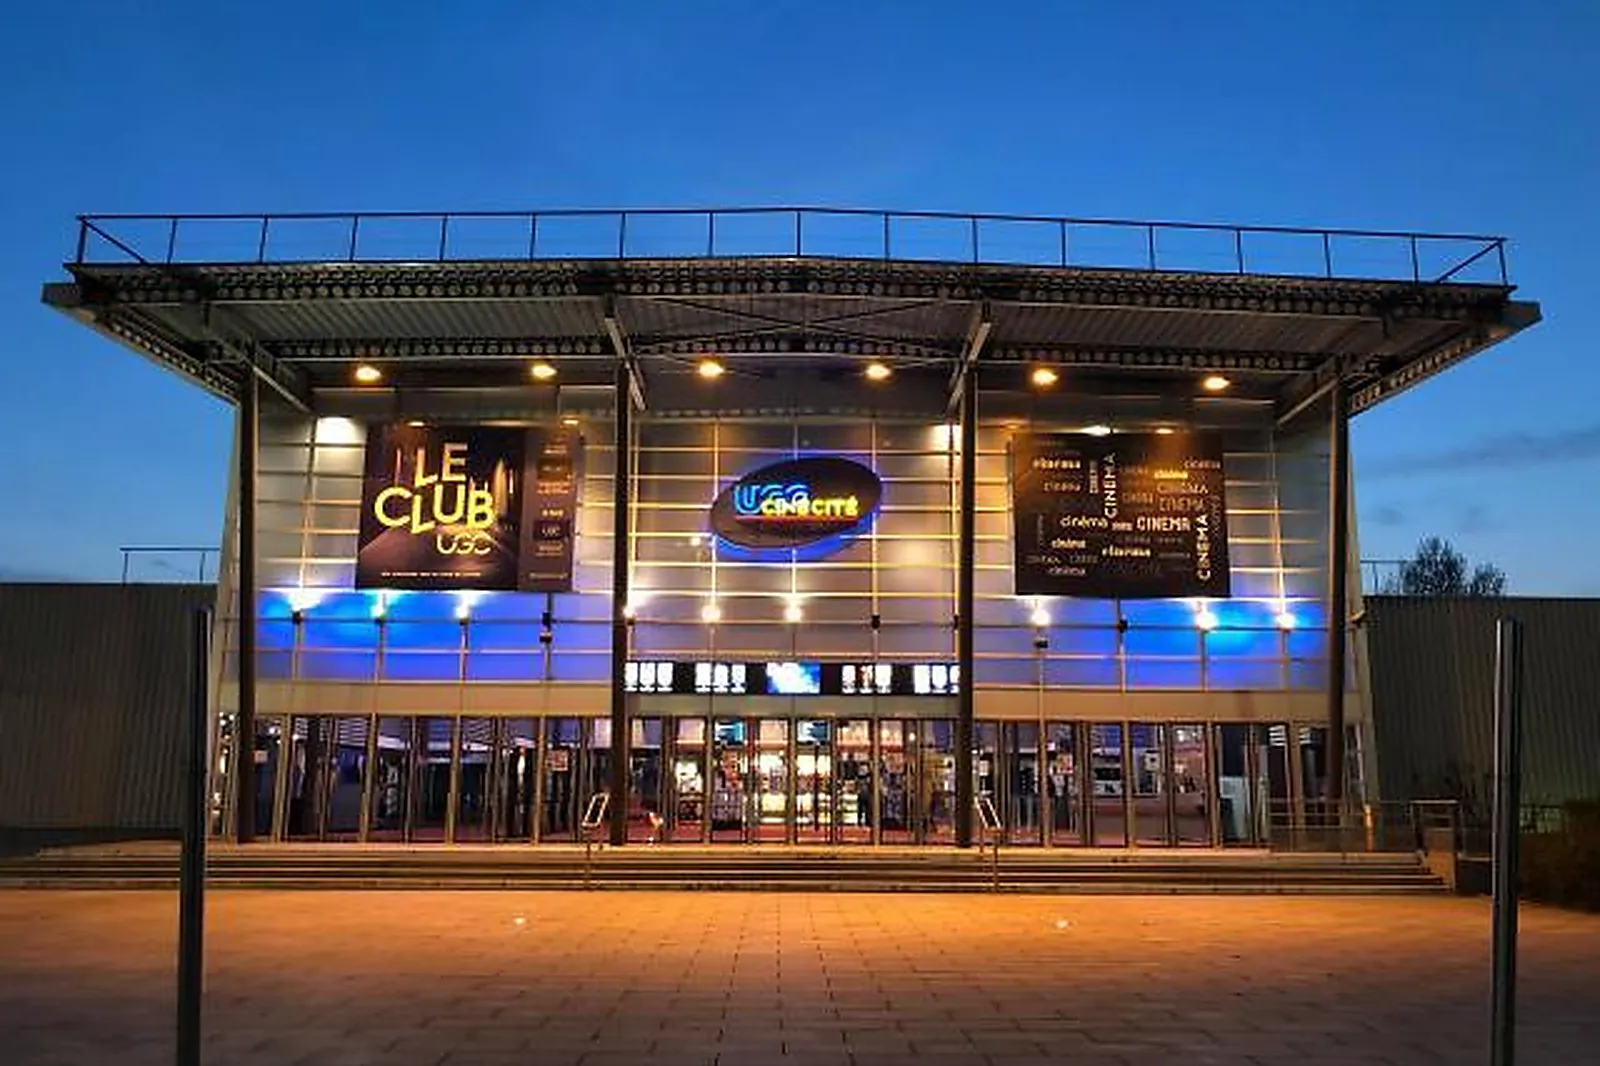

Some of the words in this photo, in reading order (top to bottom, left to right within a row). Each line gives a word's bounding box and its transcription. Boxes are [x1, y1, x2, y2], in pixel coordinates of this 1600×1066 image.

[414, 441, 469, 487] LE
[373, 469, 495, 534] CLUB
[733, 484, 809, 514] UGC
[436, 531, 492, 555] UGC
